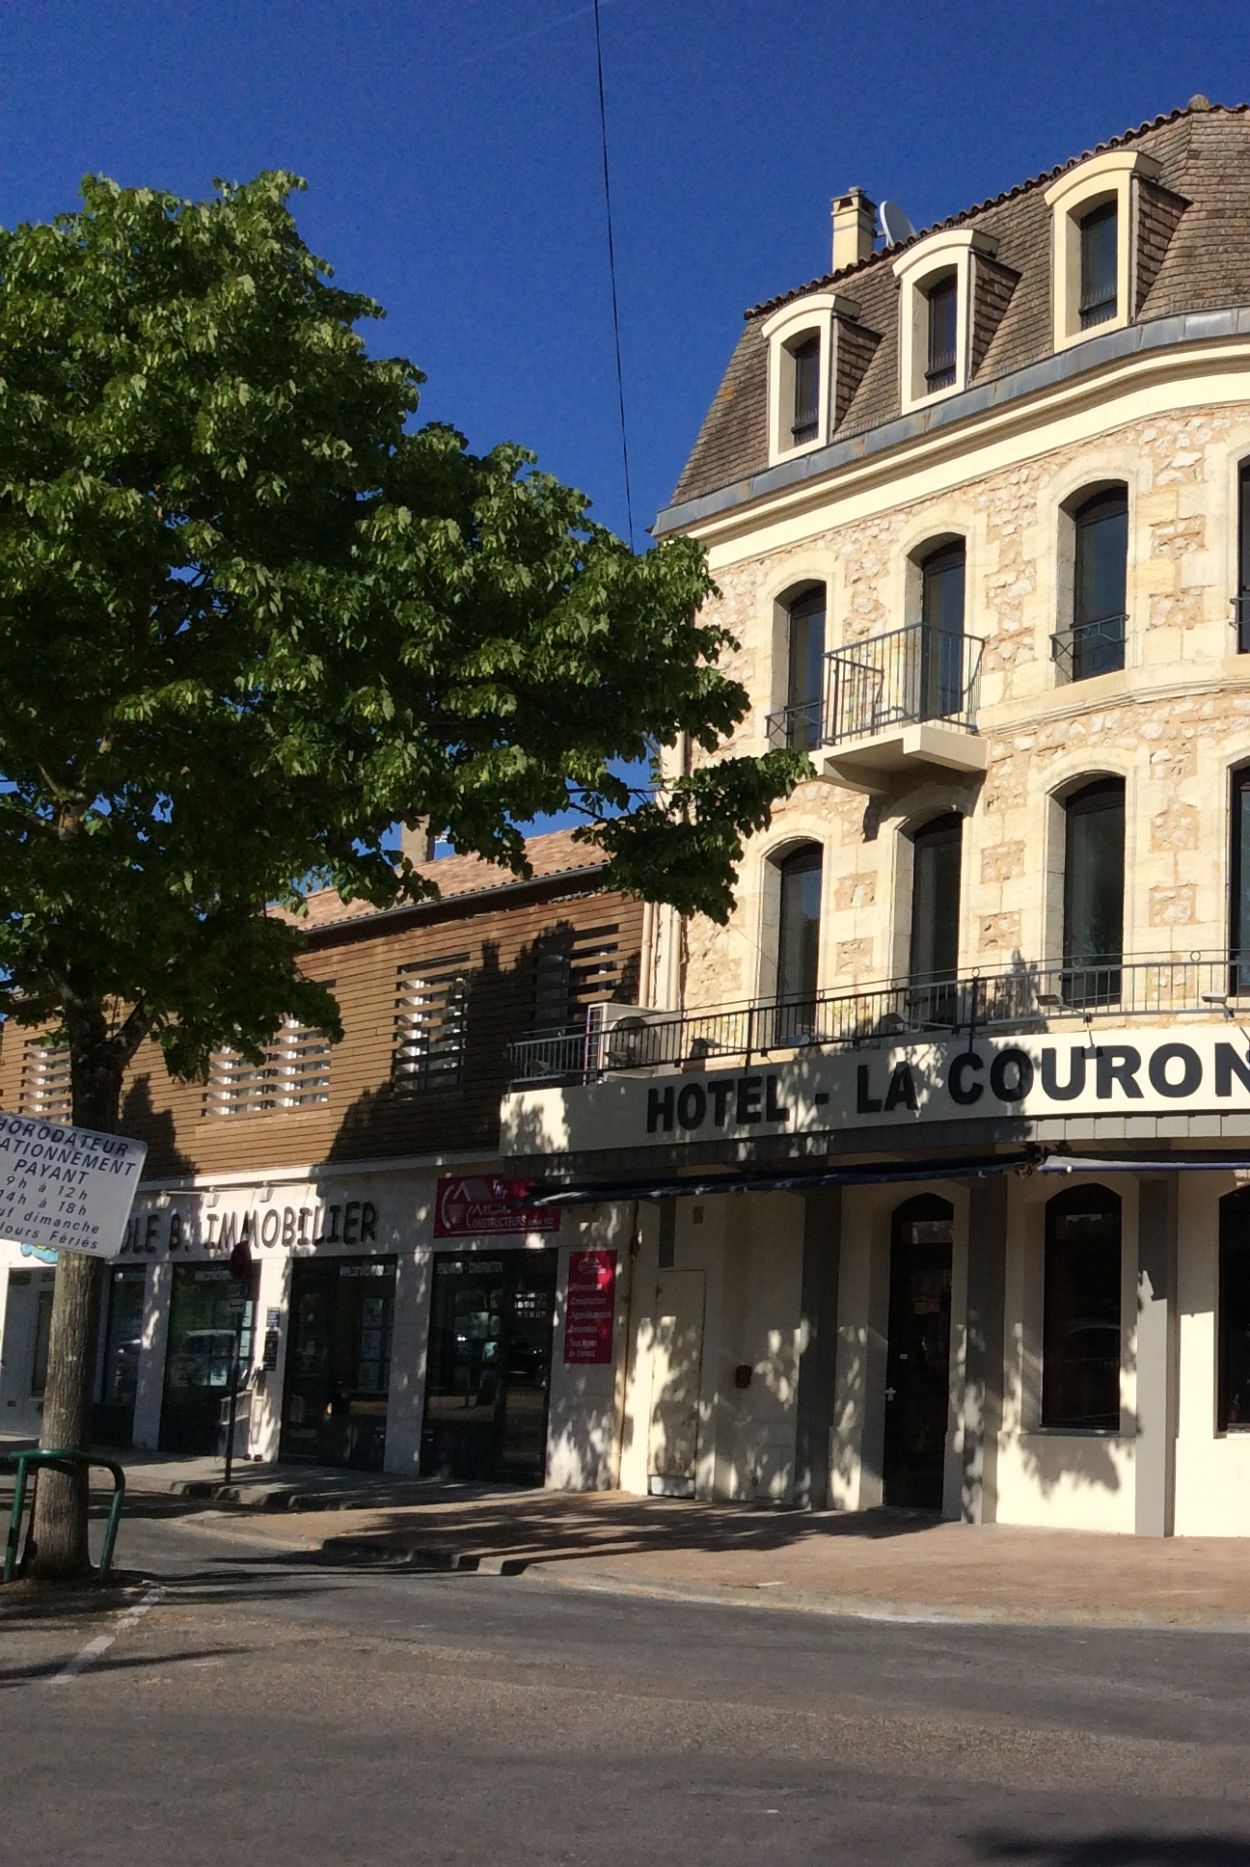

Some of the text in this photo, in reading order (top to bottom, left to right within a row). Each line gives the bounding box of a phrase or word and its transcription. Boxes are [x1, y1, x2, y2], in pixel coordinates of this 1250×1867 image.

[646, 1074, 790, 1133] HOTEL
[856, 1060, 921, 1114] LA
[0, 1137, 137, 1177] ATIONNEMENT
[13, 1158, 90, 1186] PAYANT
[6, 1175, 88, 1201] 9h à 12h
[0, 1207, 100, 1235] uf dimanche
[38, 1198, 47, 1209] à
[59, 1201, 87, 1217] 18h
[50, 1230, 98, 1250] Fériés
[168, 1213, 190, 1252] B.
[203, 1201, 379, 1250] IMMOBILIER
